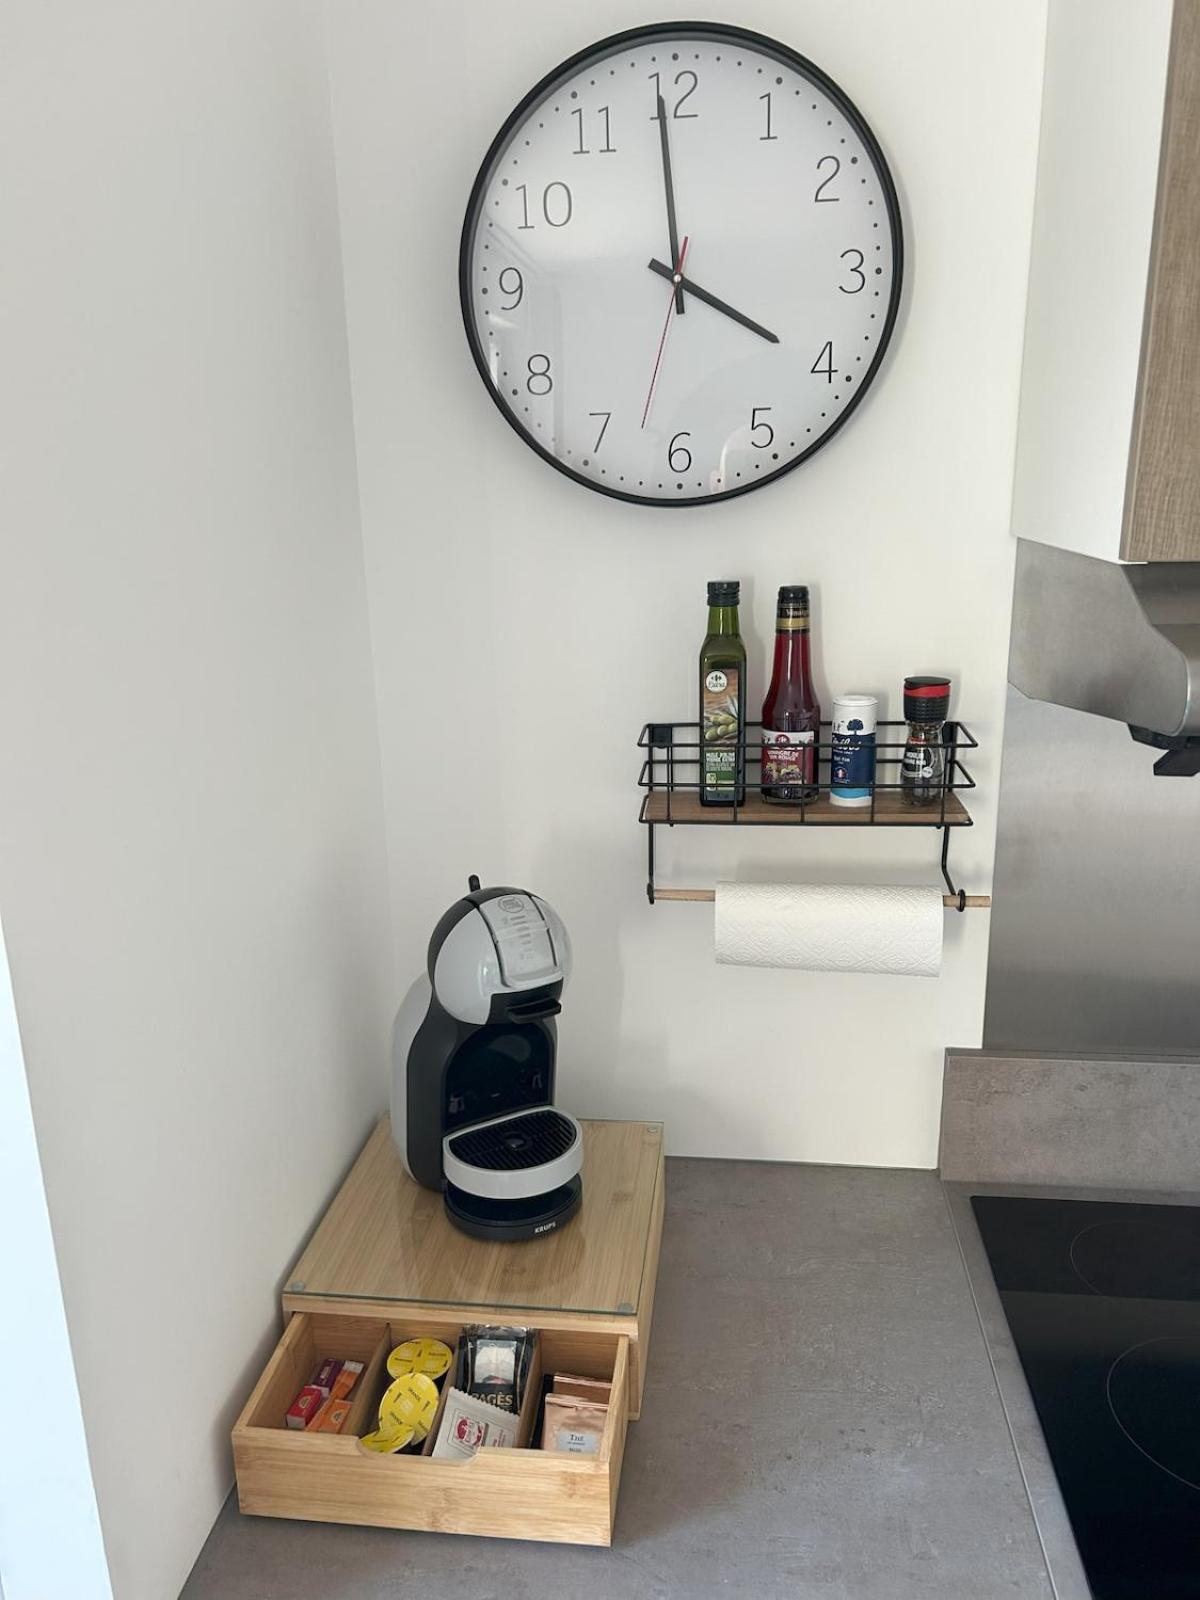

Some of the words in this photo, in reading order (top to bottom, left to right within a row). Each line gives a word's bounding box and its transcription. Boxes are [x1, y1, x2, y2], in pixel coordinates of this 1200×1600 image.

[648, 70, 699, 120] 12
[758, 92, 779, 141] 1
[570, 105, 618, 155] 11
[814, 155, 841, 203] 2
[514, 181, 573, 230] 10
[498, 267, 524, 311] 9
[837, 248, 866, 294] 3
[526, 353, 554, 396] 8
[809, 340, 839, 384] 4
[588, 411, 612, 453] 7
[750, 406, 775, 449] 5
[667, 431, 693, 474] 6
[535, 1221, 556, 1233] KRUPS
